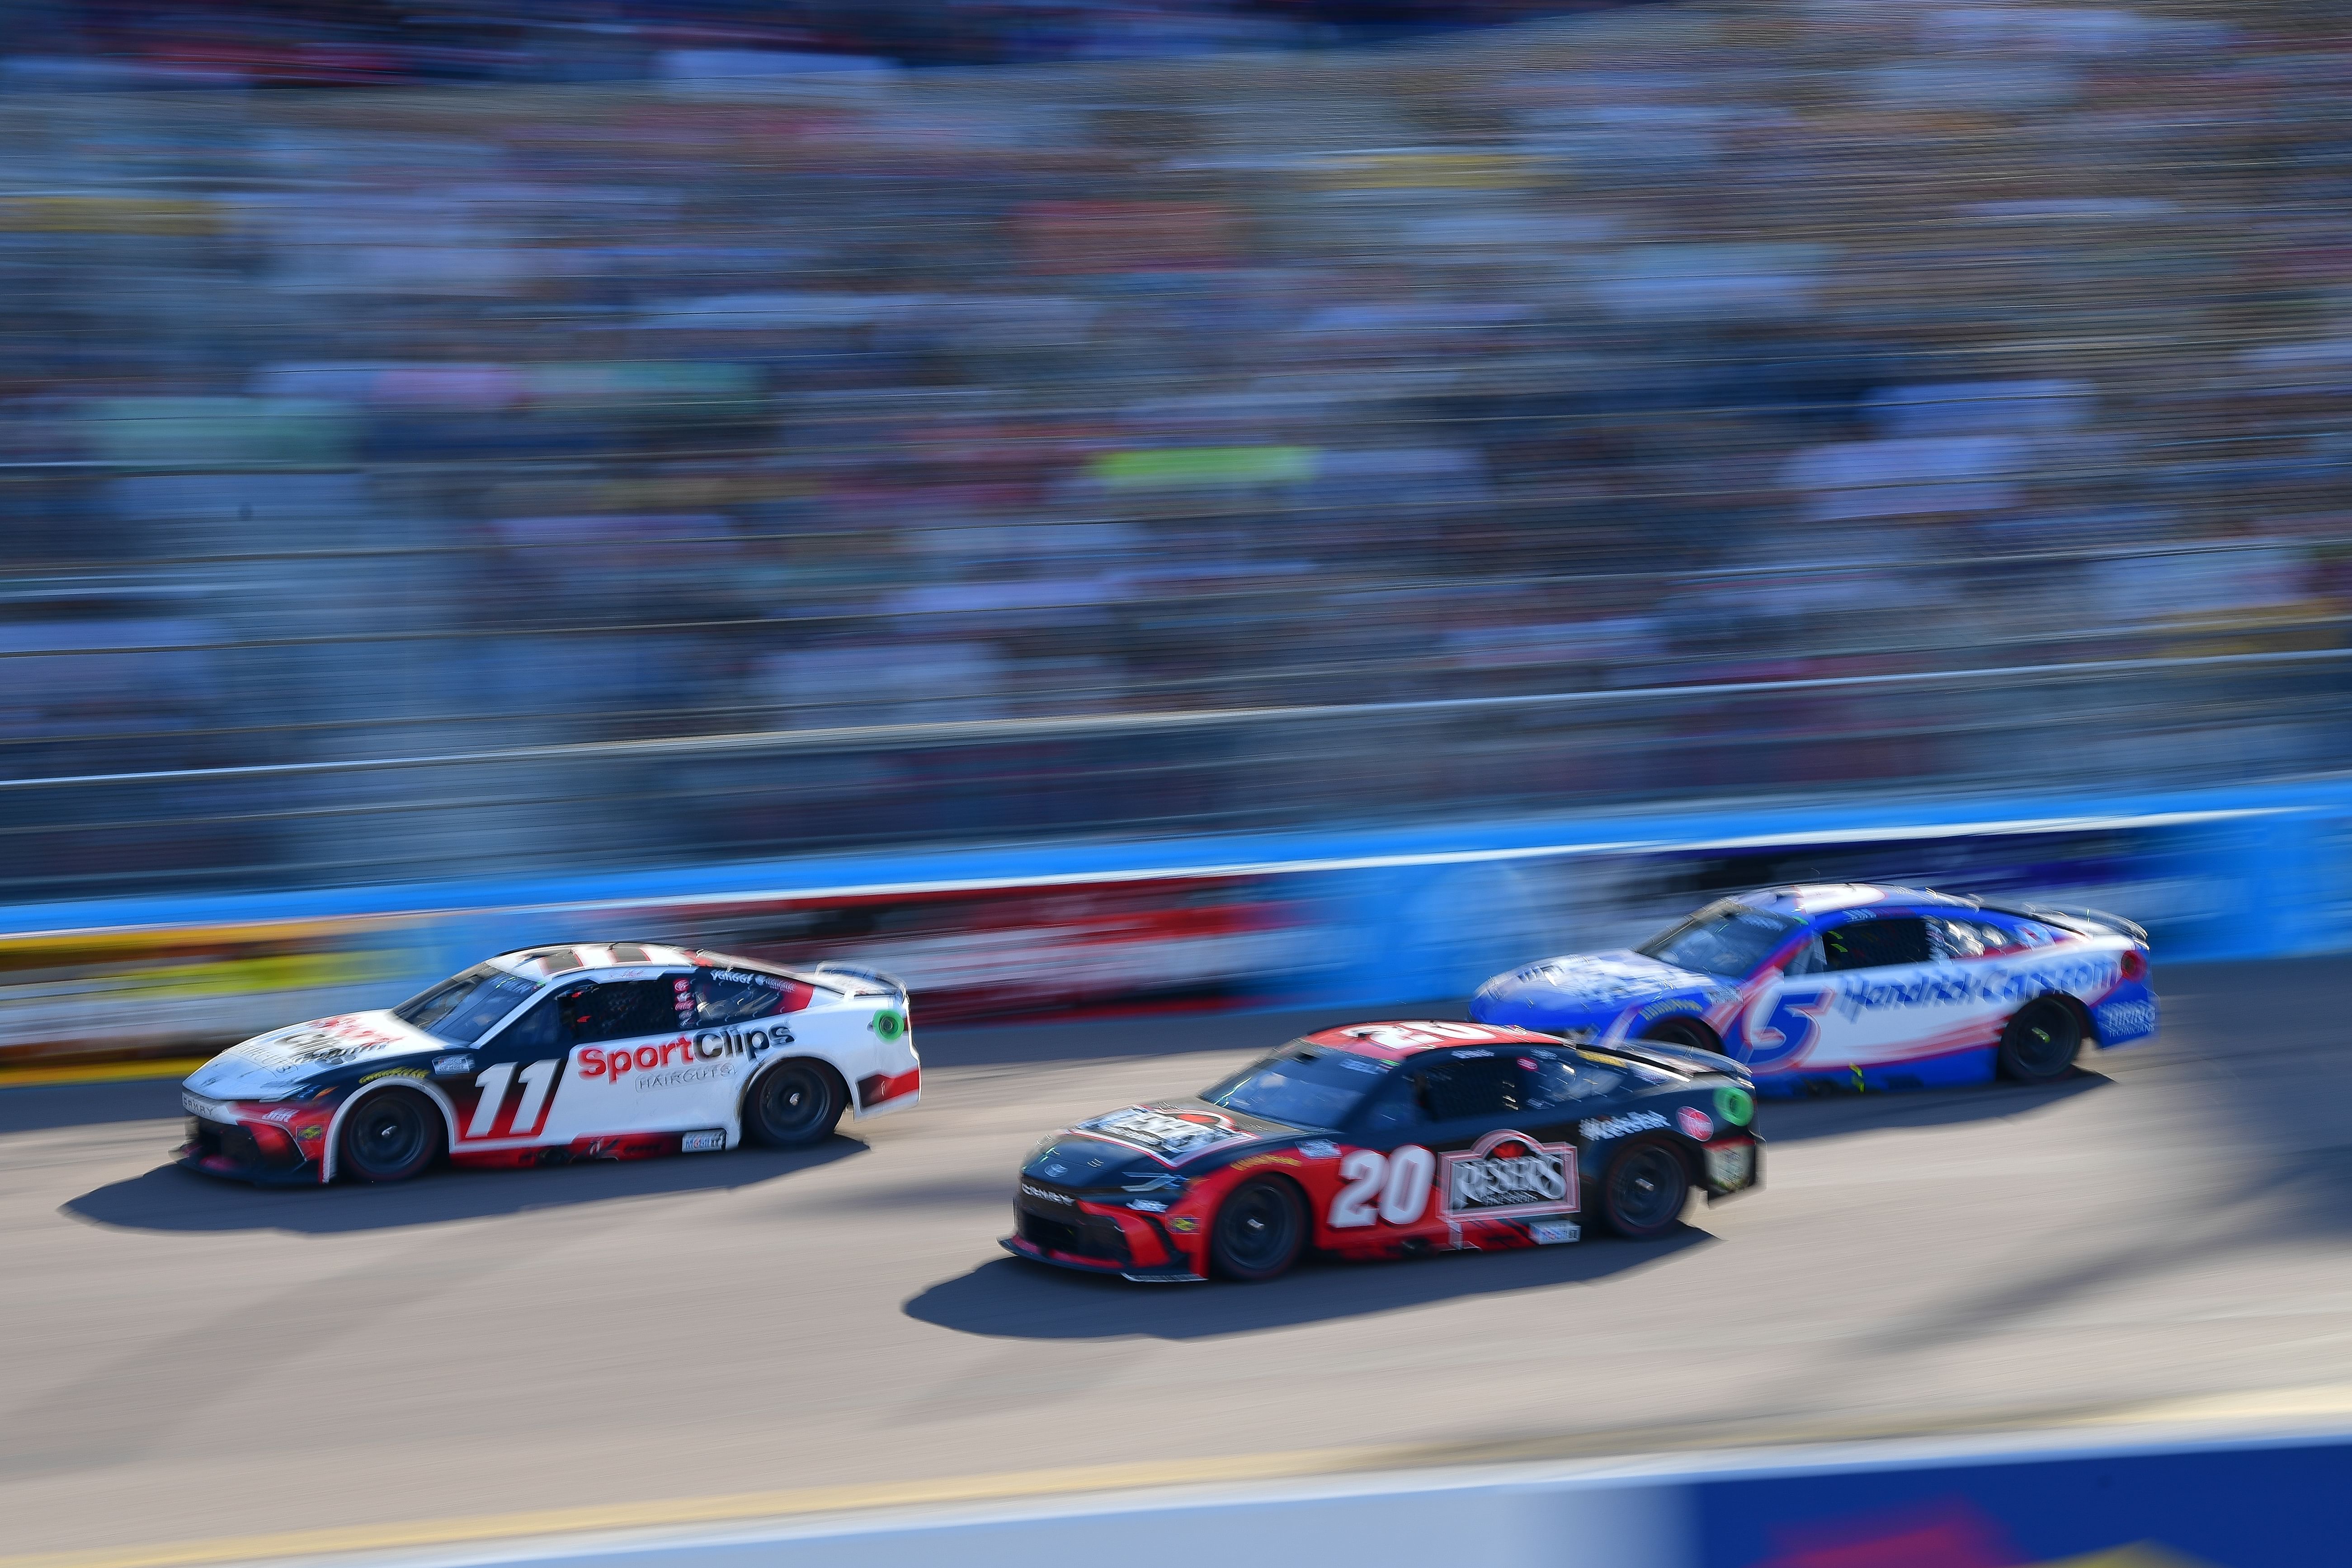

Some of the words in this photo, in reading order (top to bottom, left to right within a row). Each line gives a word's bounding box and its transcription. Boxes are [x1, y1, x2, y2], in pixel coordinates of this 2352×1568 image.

[1743, 968, 1835, 1070] 5
[2105, 1003, 2156, 1026] HIRING
[465, 1058, 561, 1138] 11
[1326, 1144, 1436, 1228] 20
